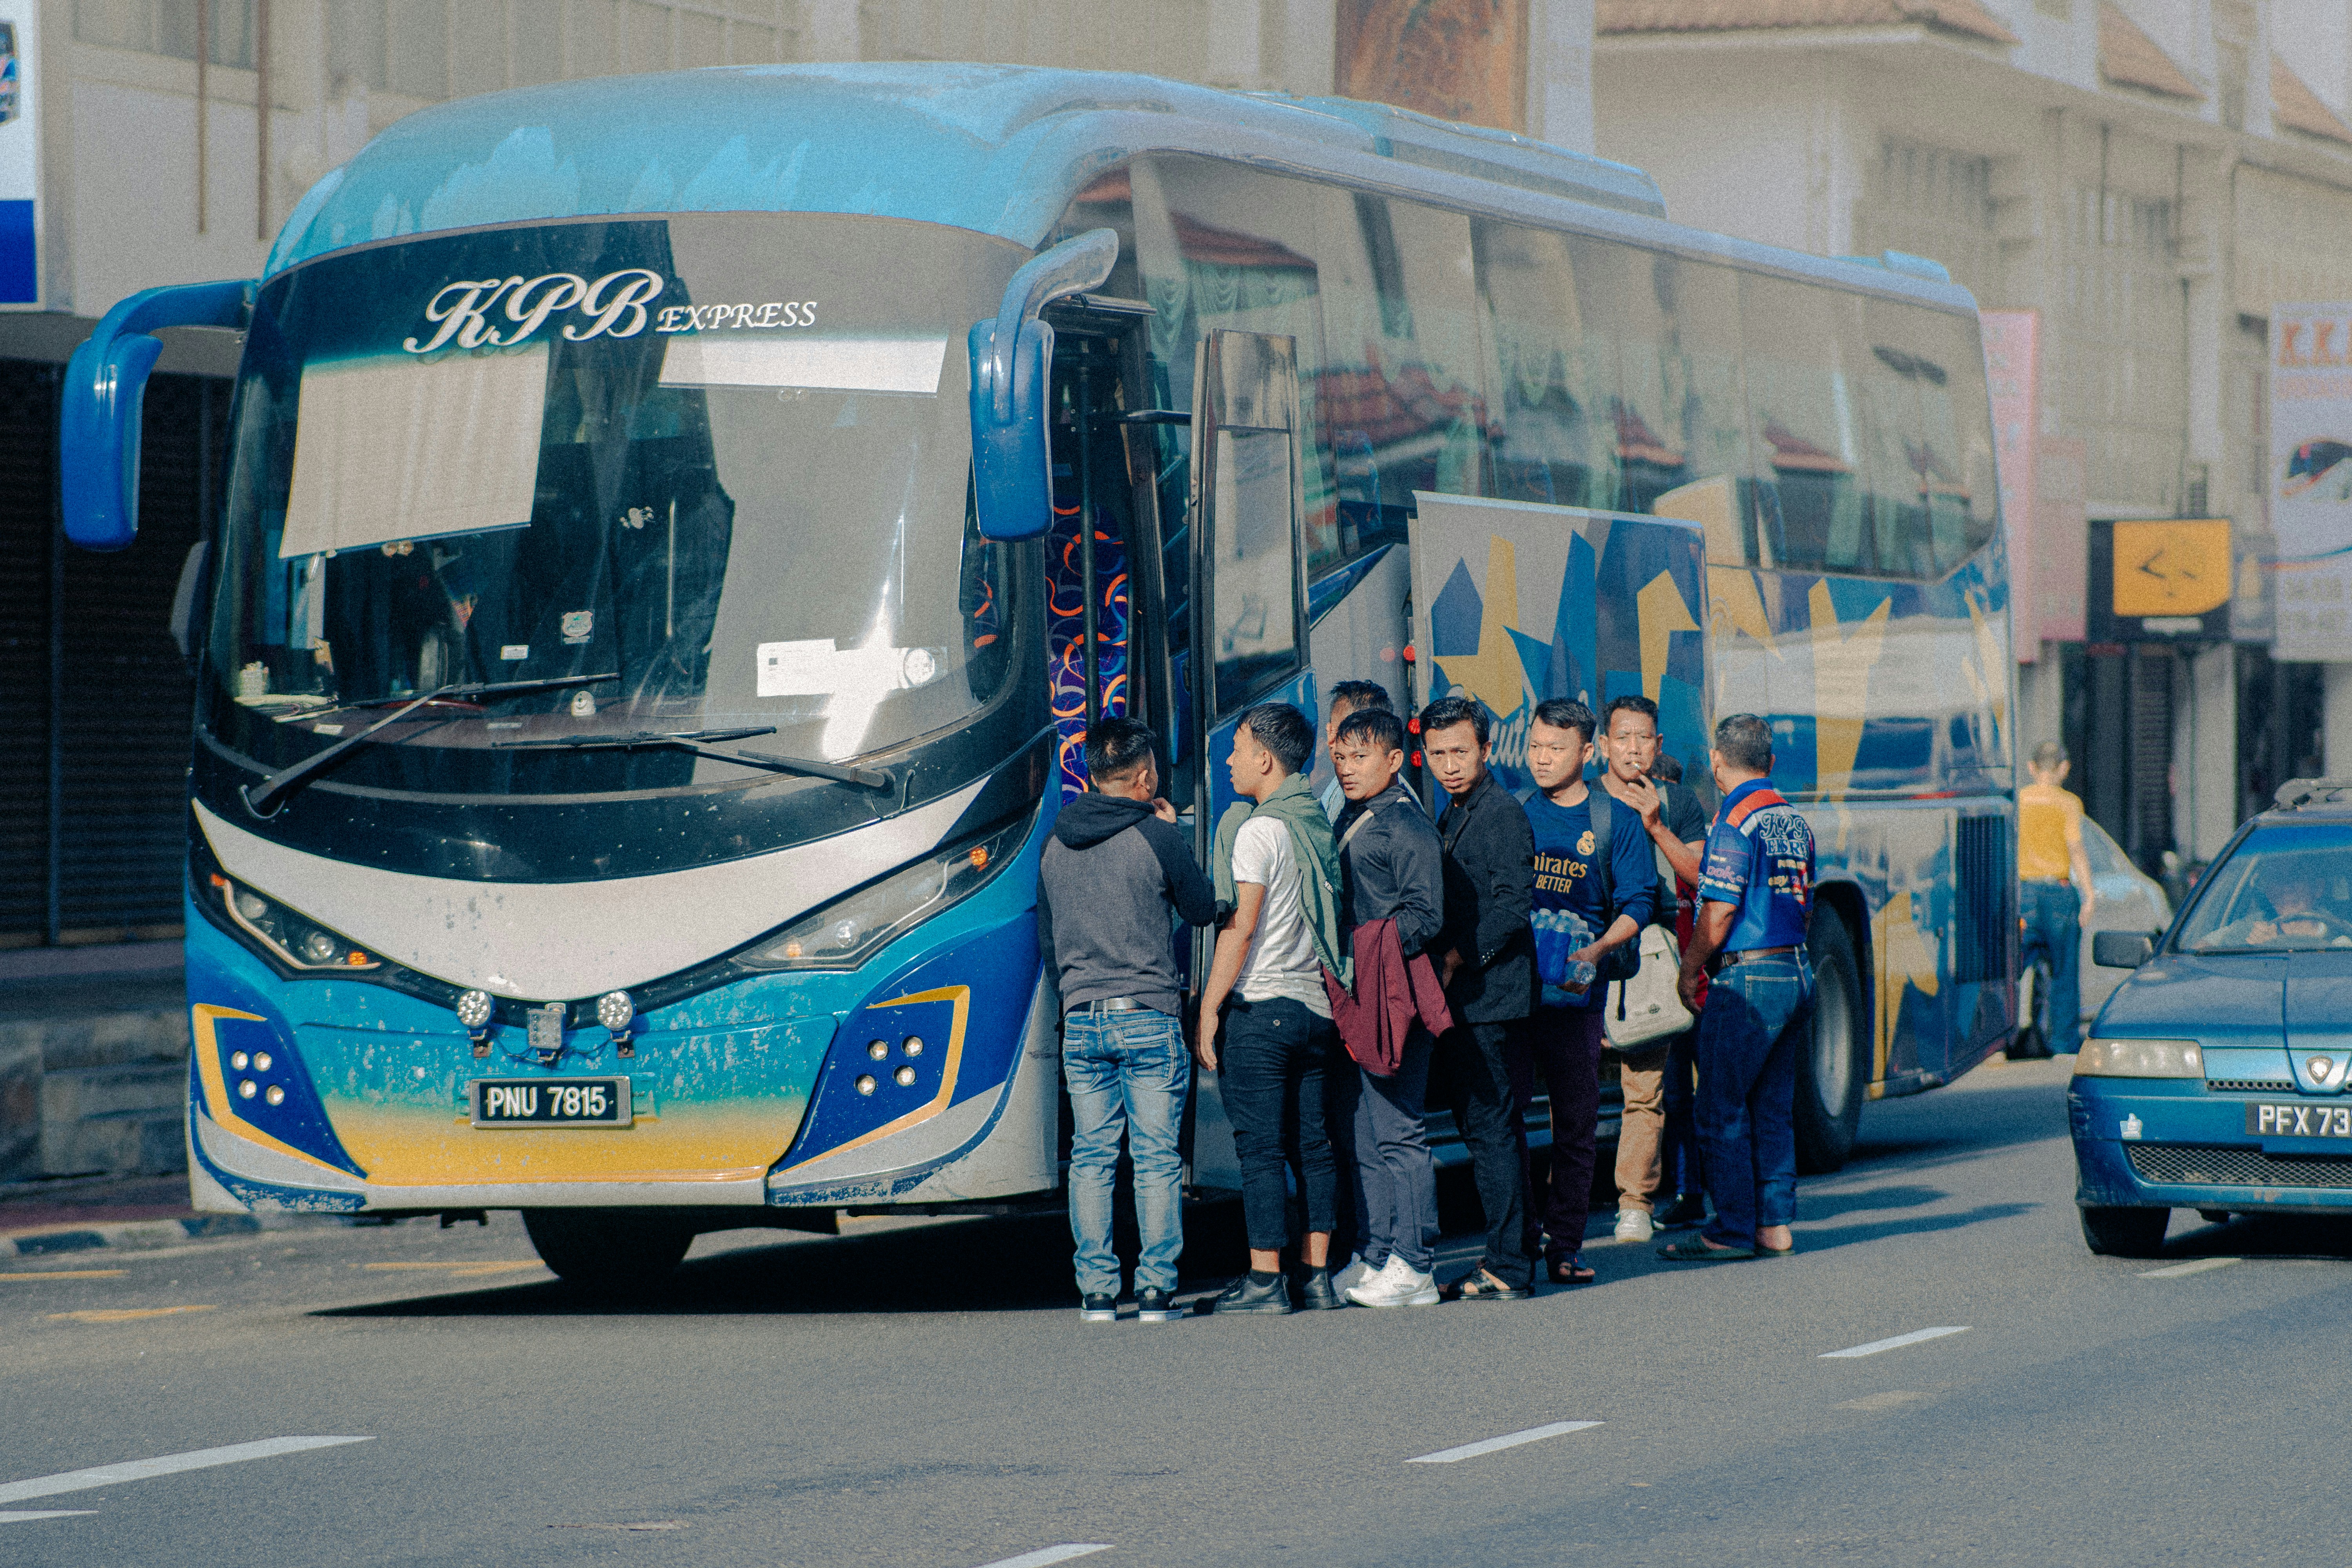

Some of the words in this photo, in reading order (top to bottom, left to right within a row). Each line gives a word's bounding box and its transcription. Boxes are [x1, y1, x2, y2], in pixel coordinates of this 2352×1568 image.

[403, 268, 663, 354] KPB
[655, 301, 817, 333] EXPRESS
[1534, 851, 1588, 878] irates
[1535, 874, 1572, 894] BETTER
[487, 1086, 538, 1117] PNU
[547, 1086, 606, 1116] 7815
[2258, 1104, 2310, 1135] PFX
[2316, 1107, 2352, 1137] 73
